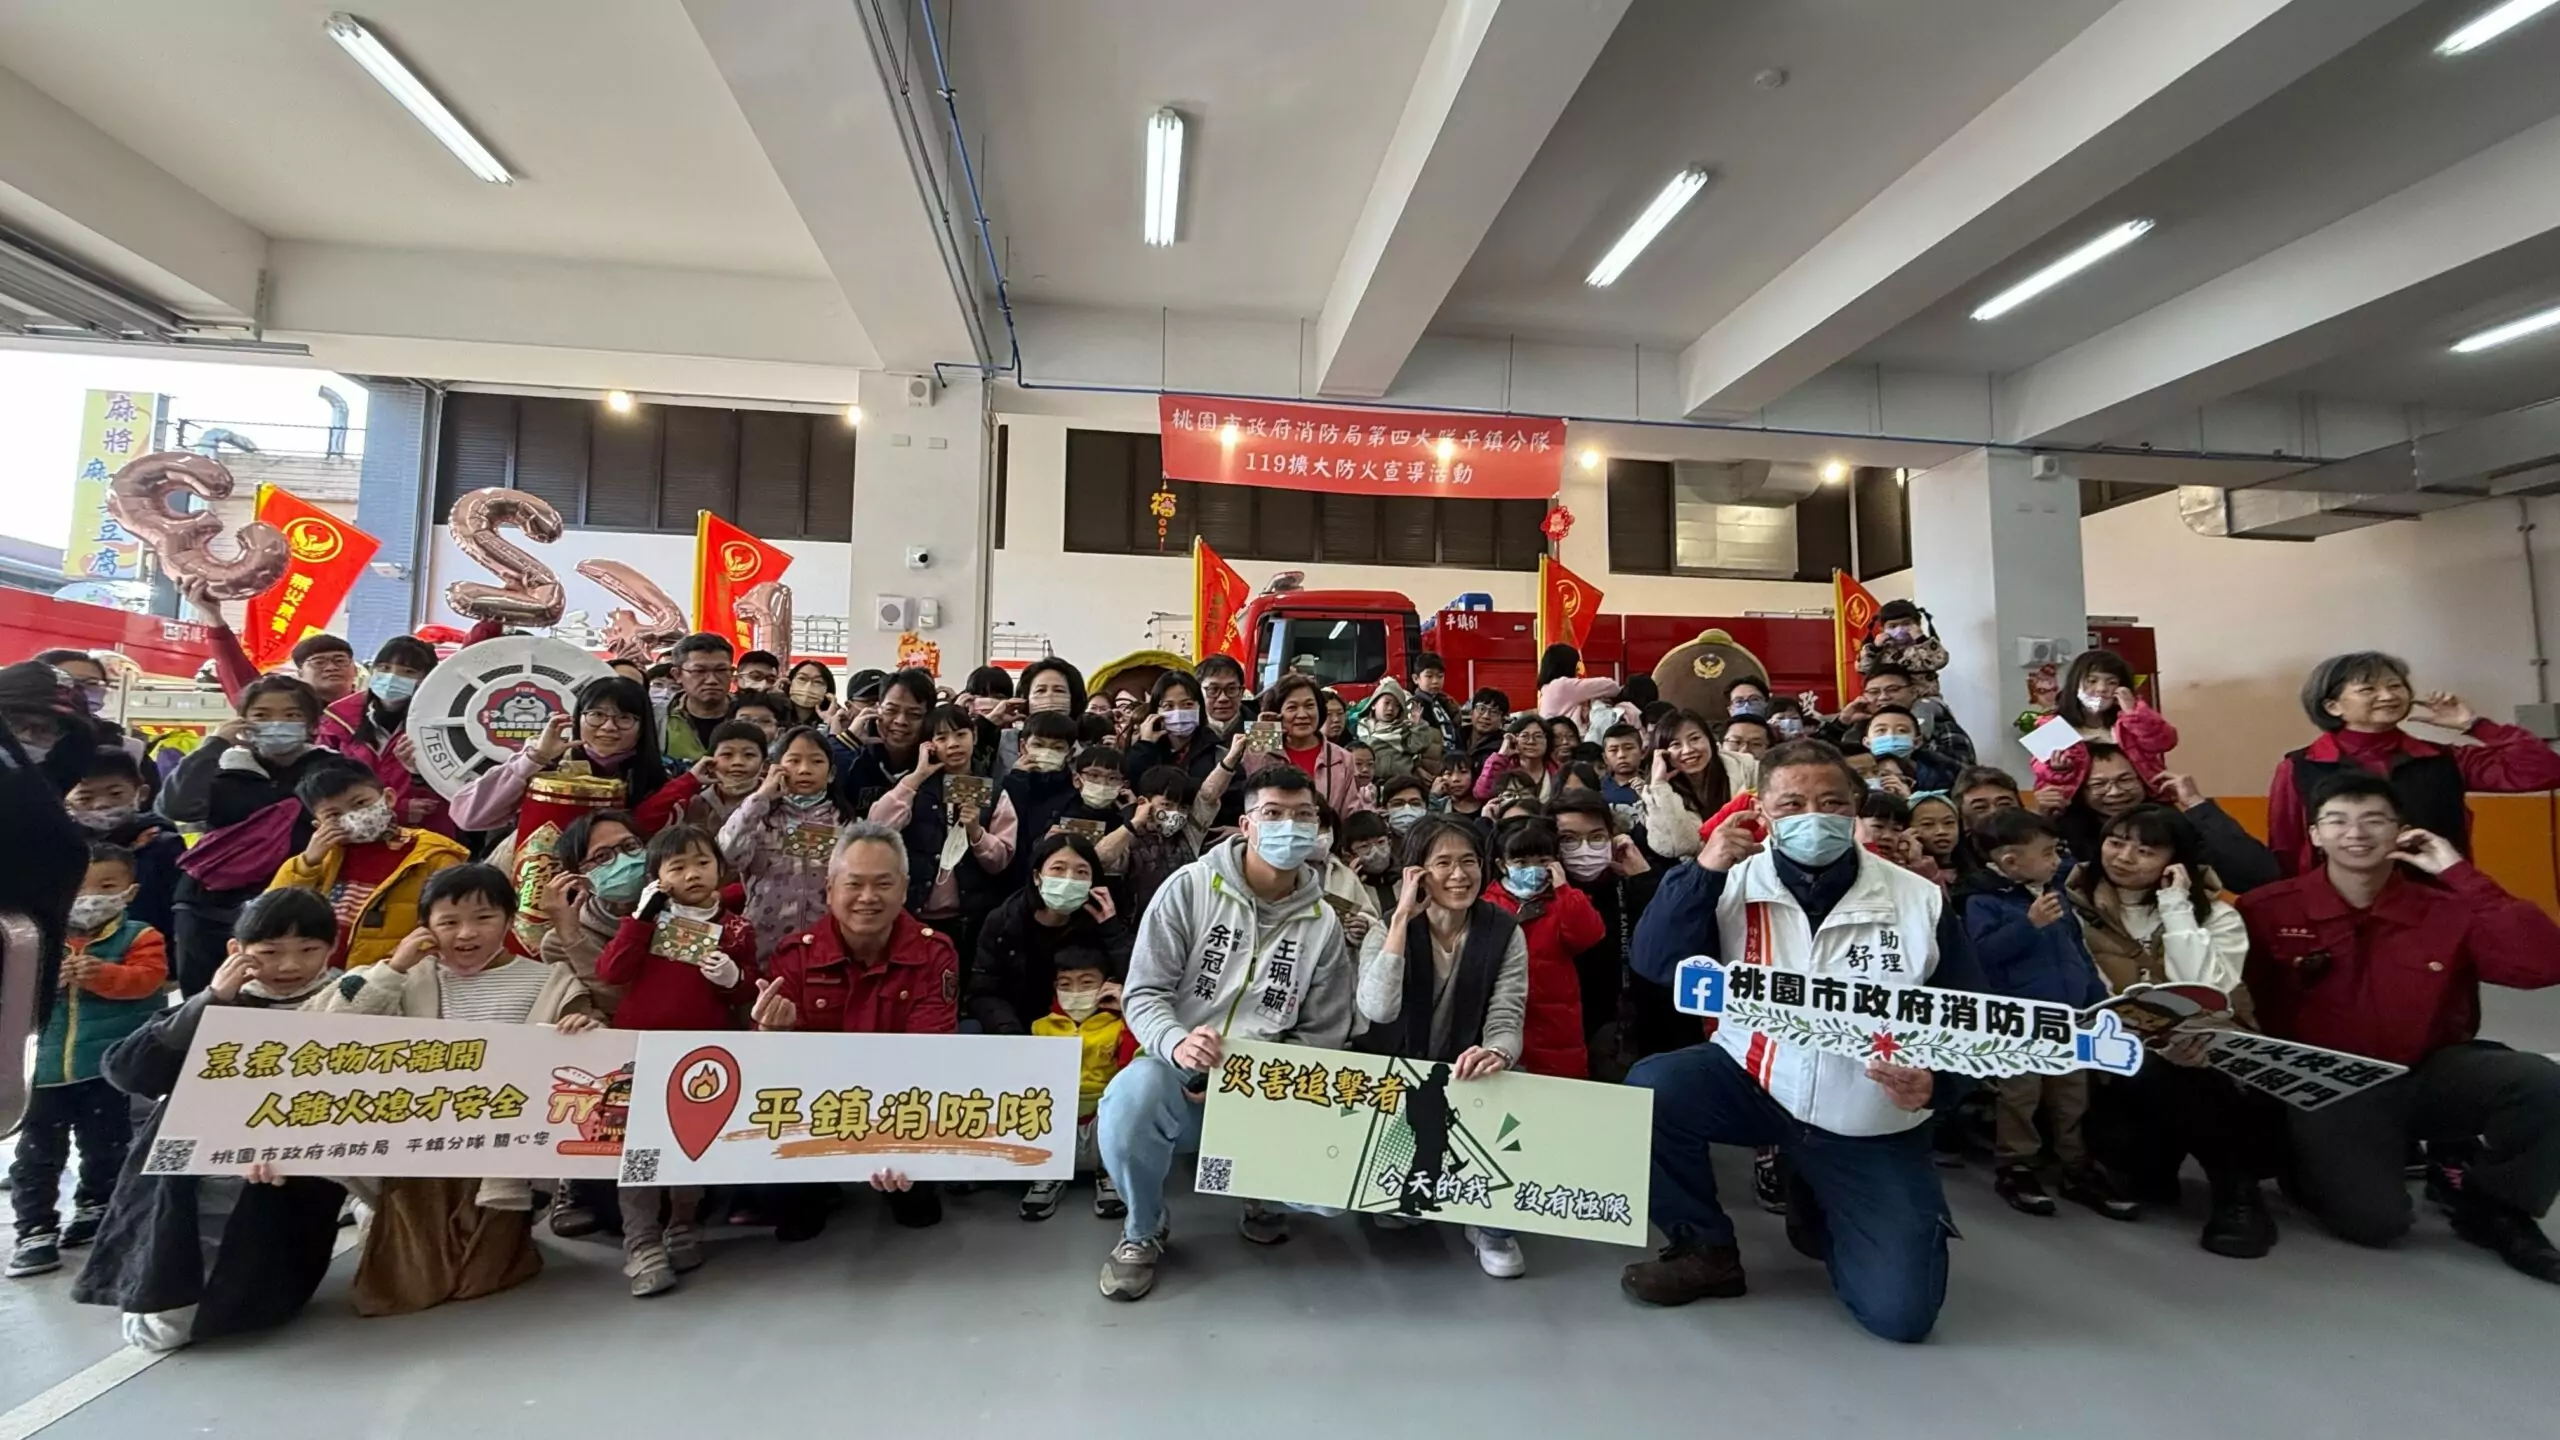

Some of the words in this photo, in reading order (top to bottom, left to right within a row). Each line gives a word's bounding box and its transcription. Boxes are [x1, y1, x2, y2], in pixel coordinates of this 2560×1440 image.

[103, 396, 137, 454] 麻將
[1245, 452, 1474, 485] 119擴大防火宣導活動
[425, 732, 453, 771] TEST
[1194, 924, 1231, 1000] 余冠霖
[1845, 944, 1874, 979] 舒
[1880, 930, 1904, 972] 助理
[1261, 939, 1297, 1012] 王珮毓
[1728, 965, 2072, 1045] 桃園市政府消防局
[197, 1038, 488, 1079] 烹煮食物不離開
[2225, 1037, 2393, 1087] 小火快逃
[245, 1082, 530, 1129] 人離火熄才安全
[547, 1091, 603, 1124] TY
[1220, 1053, 1407, 1114] 災害追擊者
[749, 1086, 1054, 1141] 平鎮消防隊
[210, 1138, 390, 1165] 桃園市政府消防局
[406, 1134, 486, 1153] 平鎮分隊
[493, 1131, 550, 1149] 關心您
[1376, 1165, 1492, 1208] 今天的我
[1514, 1181, 1633, 1225] 沒有極限
